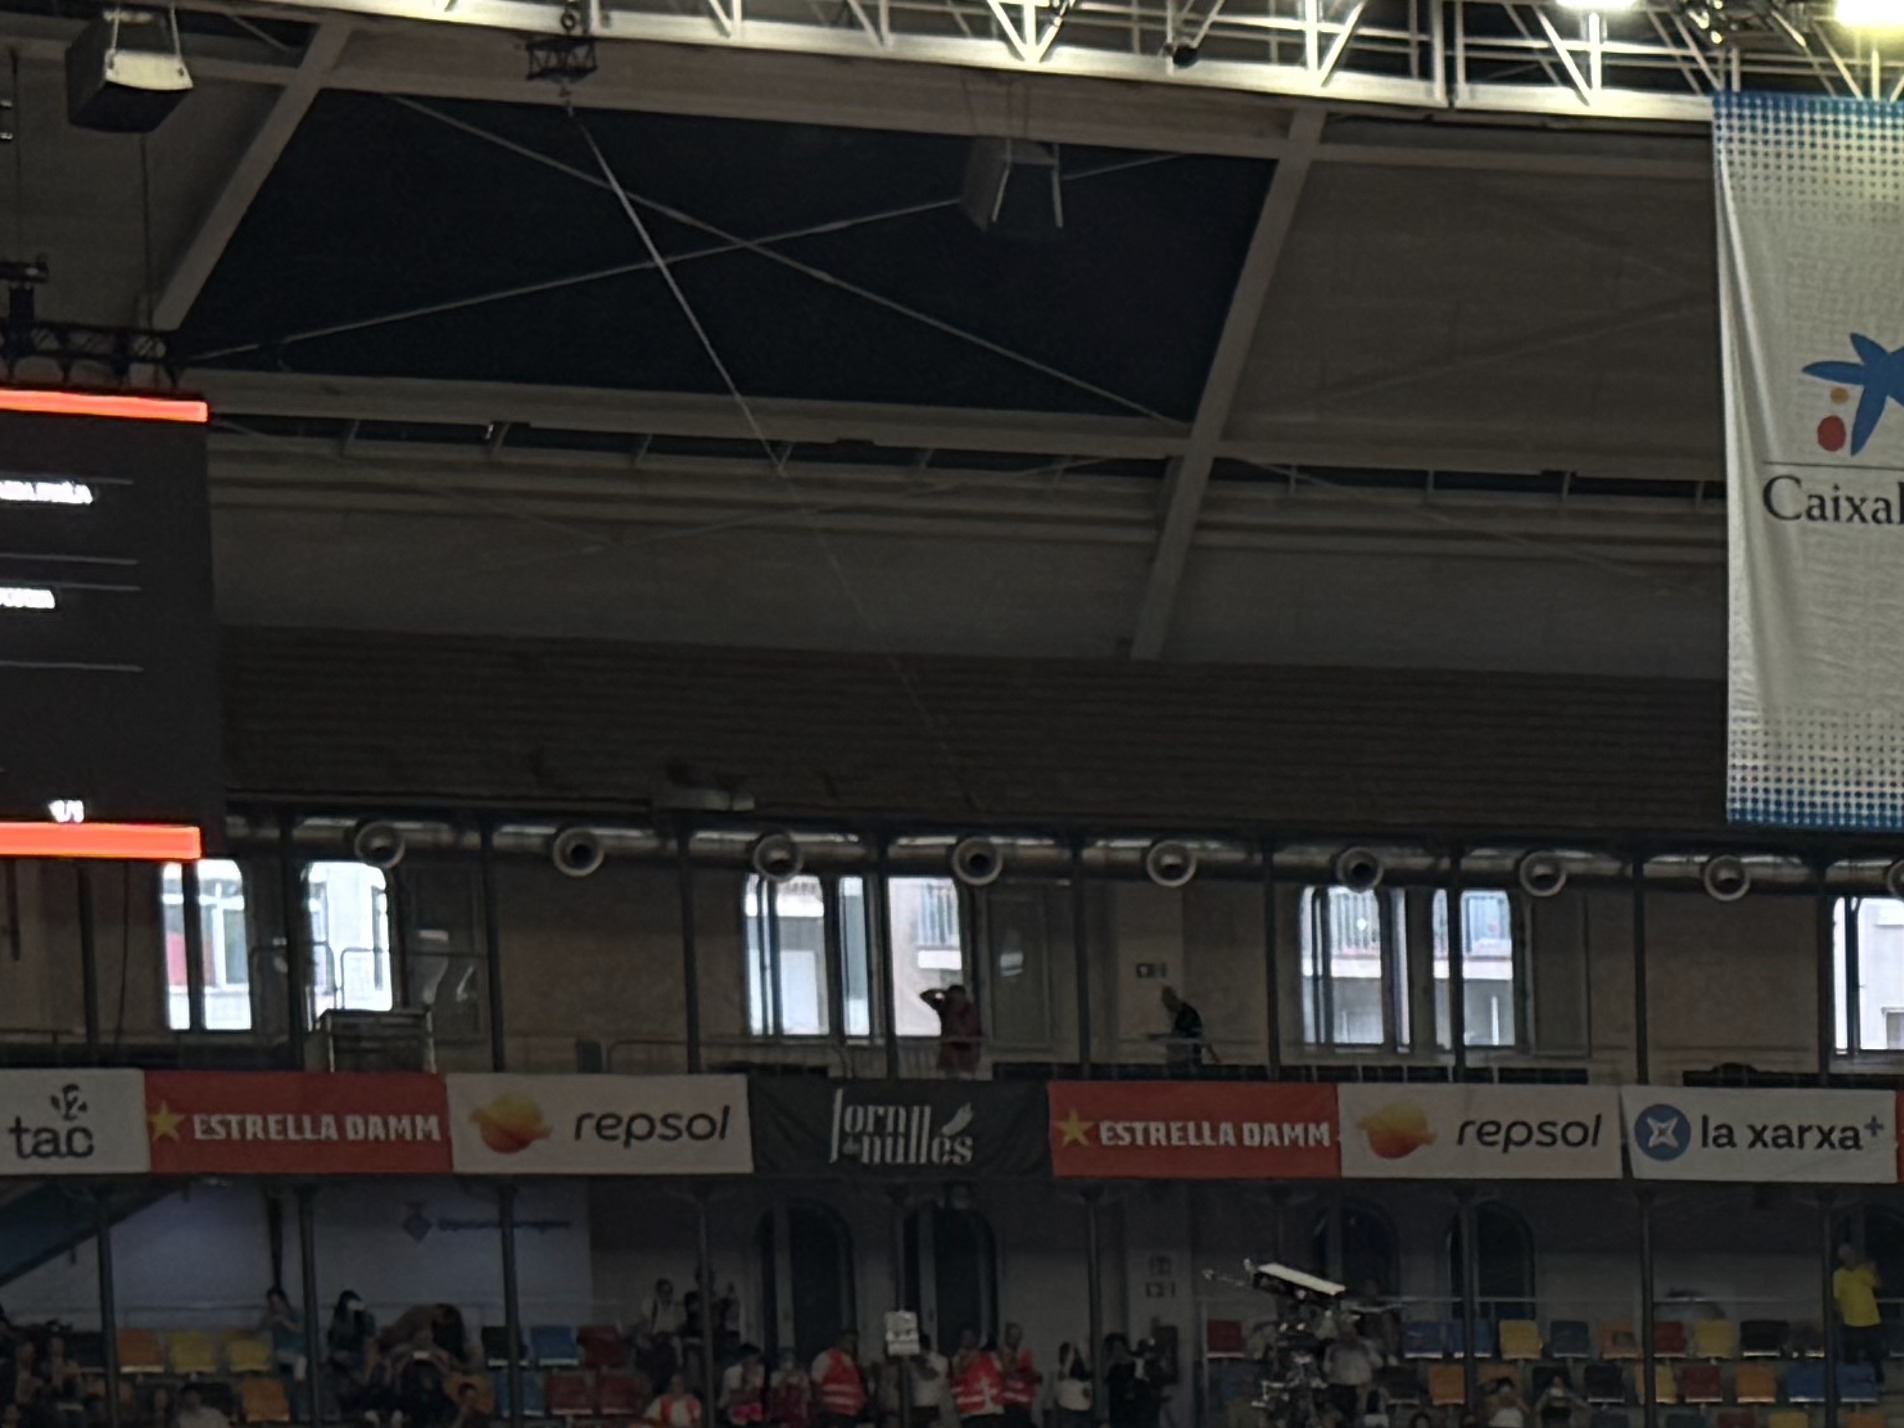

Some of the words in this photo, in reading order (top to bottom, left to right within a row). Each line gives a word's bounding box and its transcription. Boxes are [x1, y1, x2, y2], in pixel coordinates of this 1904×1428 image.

[193, 1114, 339, 1141] ESTRELLA
[346, 1114, 441, 1141] DAMM
[574, 1105, 731, 1149] repsol
[1100, 1120, 1237, 1147] ESTRELLA
[1243, 1120, 1331, 1147] DAMM
[1456, 1113, 1602, 1154] repsol
[1701, 1114, 1737, 1149] la
